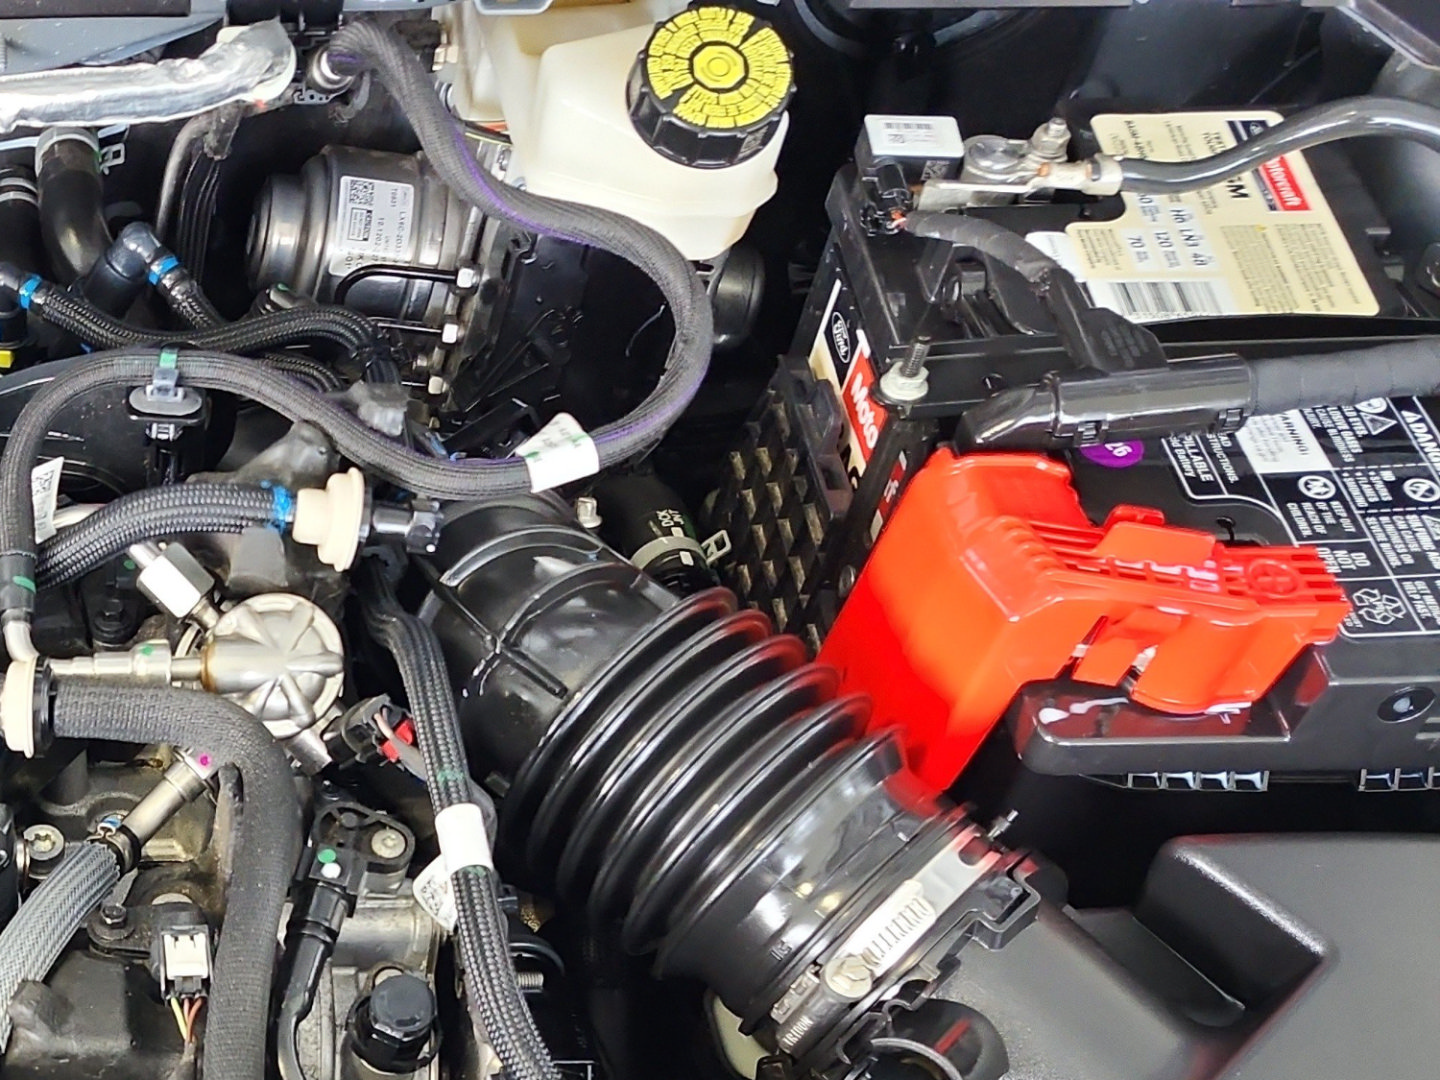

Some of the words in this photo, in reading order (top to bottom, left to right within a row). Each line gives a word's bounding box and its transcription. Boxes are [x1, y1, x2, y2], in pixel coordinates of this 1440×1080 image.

[1266, 156, 1302, 206] otorcraft
[851, 372, 879, 450] Moto
[1348, 417, 1369, 437] EYES.
[1326, 428, 1356, 462] BLINDNESS
[1327, 406, 1350, 430] LOSIVE
[1340, 430, 1363, 453] GASES
[1174, 448, 1197, 478] Battery
[1184, 434, 1215, 482] PILLABLE
[1206, 433, 1239, 484] STRUCTIONS.
[1379, 470, 1396, 482] NO
[1286, 502, 1313, 538] CHILDREN.
[1301, 502, 1321, 524] REACH
[1313, 524, 1328, 535] OF
[1315, 501, 1329, 511] OF
[1321, 511, 1337, 524] THE
[1328, 501, 1348, 518] KEEP
[1339, 518, 1356, 532] OUT
[1392, 515, 1409, 529] CAN
[1365, 516, 1388, 542] SEVERE
[1379, 542, 1402, 569] BURNS.
[1378, 516, 1408, 553] BLINDNESS
[1400, 553, 1415, 564] OR
[1400, 530, 1421, 551] CAUSE
[1332, 550, 1357, 570] NOT
[1350, 552, 1371, 567] DO
[1401, 581, 1421, 599] HELP
[1412, 600, 1432, 619] FAST.
[1414, 580, 1431, 593] GET
